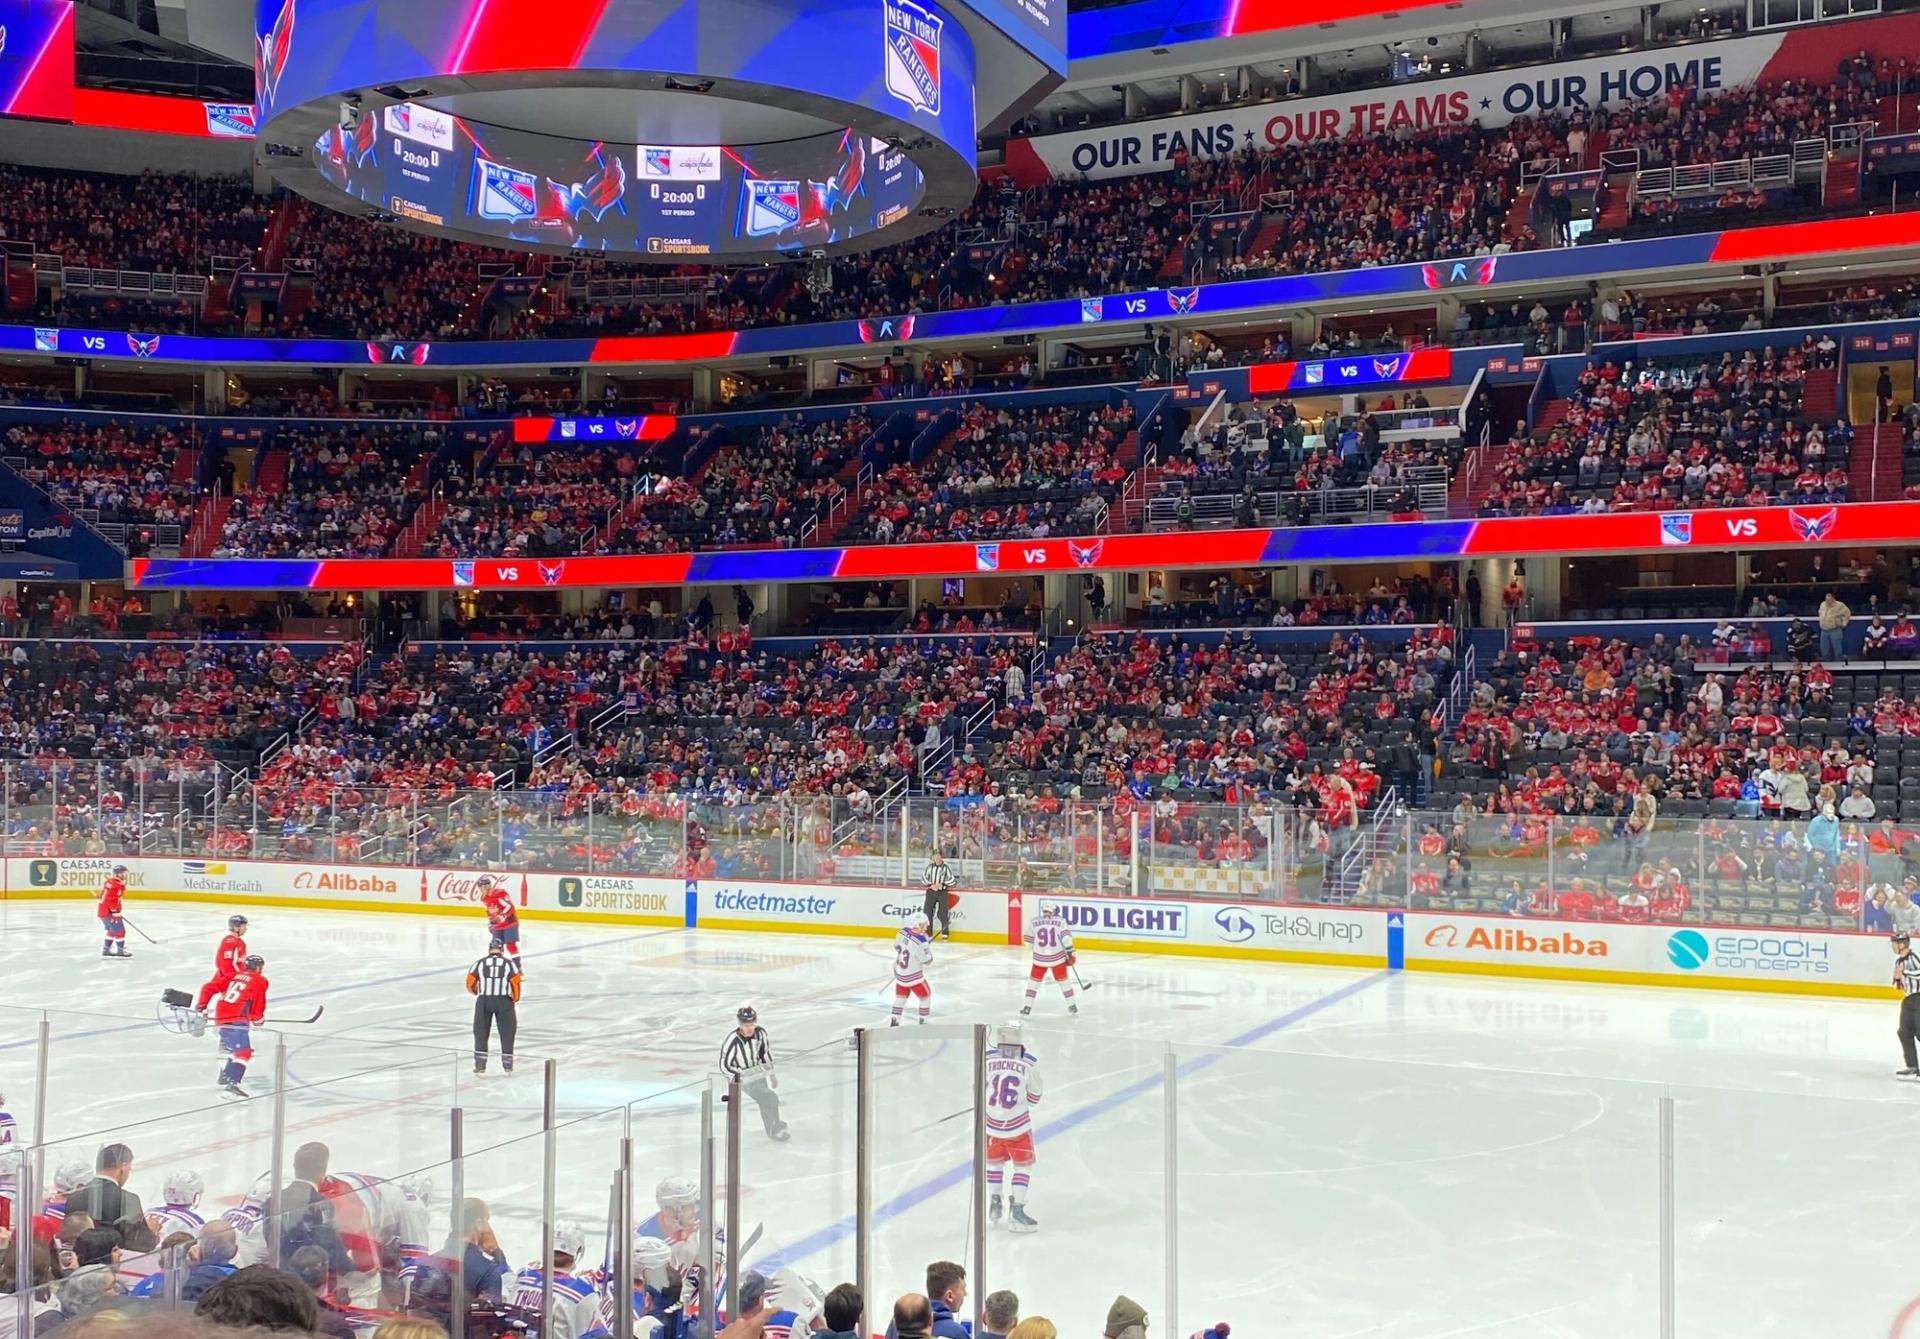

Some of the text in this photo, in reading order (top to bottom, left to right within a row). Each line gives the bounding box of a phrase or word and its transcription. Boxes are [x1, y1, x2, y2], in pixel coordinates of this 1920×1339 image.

[889, 5, 937, 45] NEW YORK
[896, 34, 937, 105] RANGERS
[1072, 57, 1721, 171] OUR FANS OUR TEAMS OUR HOME
[403, 151, 429, 168] 20:00
[488, 168, 534, 184] NEW YORK
[495, 181, 533, 213] RANGERS
[662, 192, 694, 204] 20:00
[763, 196, 797, 219] RANGERS
[663, 245, 710, 254] SPORTSBOOK
[1125, 299, 1146, 313] VS
[83, 336, 105, 349] VS
[1340, 365, 1358, 377] VS
[589, 424, 604, 434] VS
[1726, 518, 1758, 536] VS
[1023, 549, 1046, 563] VS
[497, 567, 518, 580] VS
[60, 860, 112, 870] CAESARS
[184, 878, 262, 893] MedStar Health
[317, 872, 397, 893] Alibaba
[585, 878, 634, 890] CAESARS
[585, 892, 667, 911] SPORTSBOOK
[714, 889, 836, 915] ticketmaster
[1103, 908, 1182, 931] LIGHT
[1037, 927, 1057, 947] 91
[1261, 914, 1363, 943] TekSynap
[1465, 927, 1608, 956] Alibaba
[1715, 937, 1828, 958] EPOCH
[489, 966, 499, 977] 11
[1715, 956, 1829, 973] CONCEPTS
[988, 1075, 1020, 1109] 16
